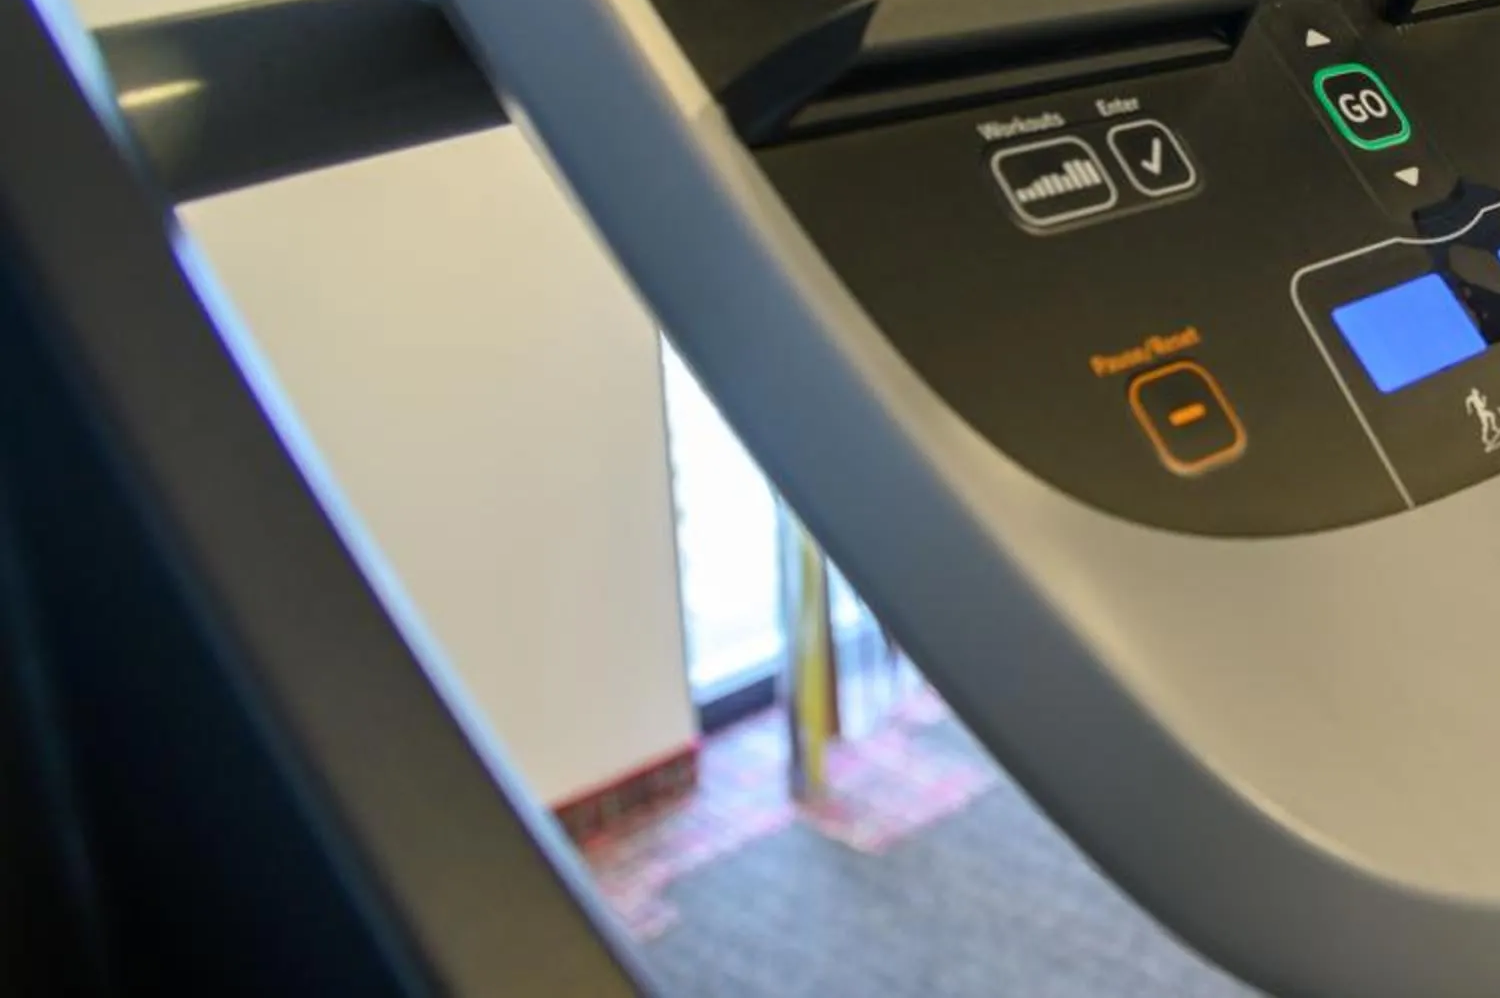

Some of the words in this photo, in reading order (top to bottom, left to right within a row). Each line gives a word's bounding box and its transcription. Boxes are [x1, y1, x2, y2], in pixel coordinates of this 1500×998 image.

[1094, 98, 1140, 118] Enter
[1338, 88, 1389, 123] GO
[975, 111, 1067, 142] Workouts
